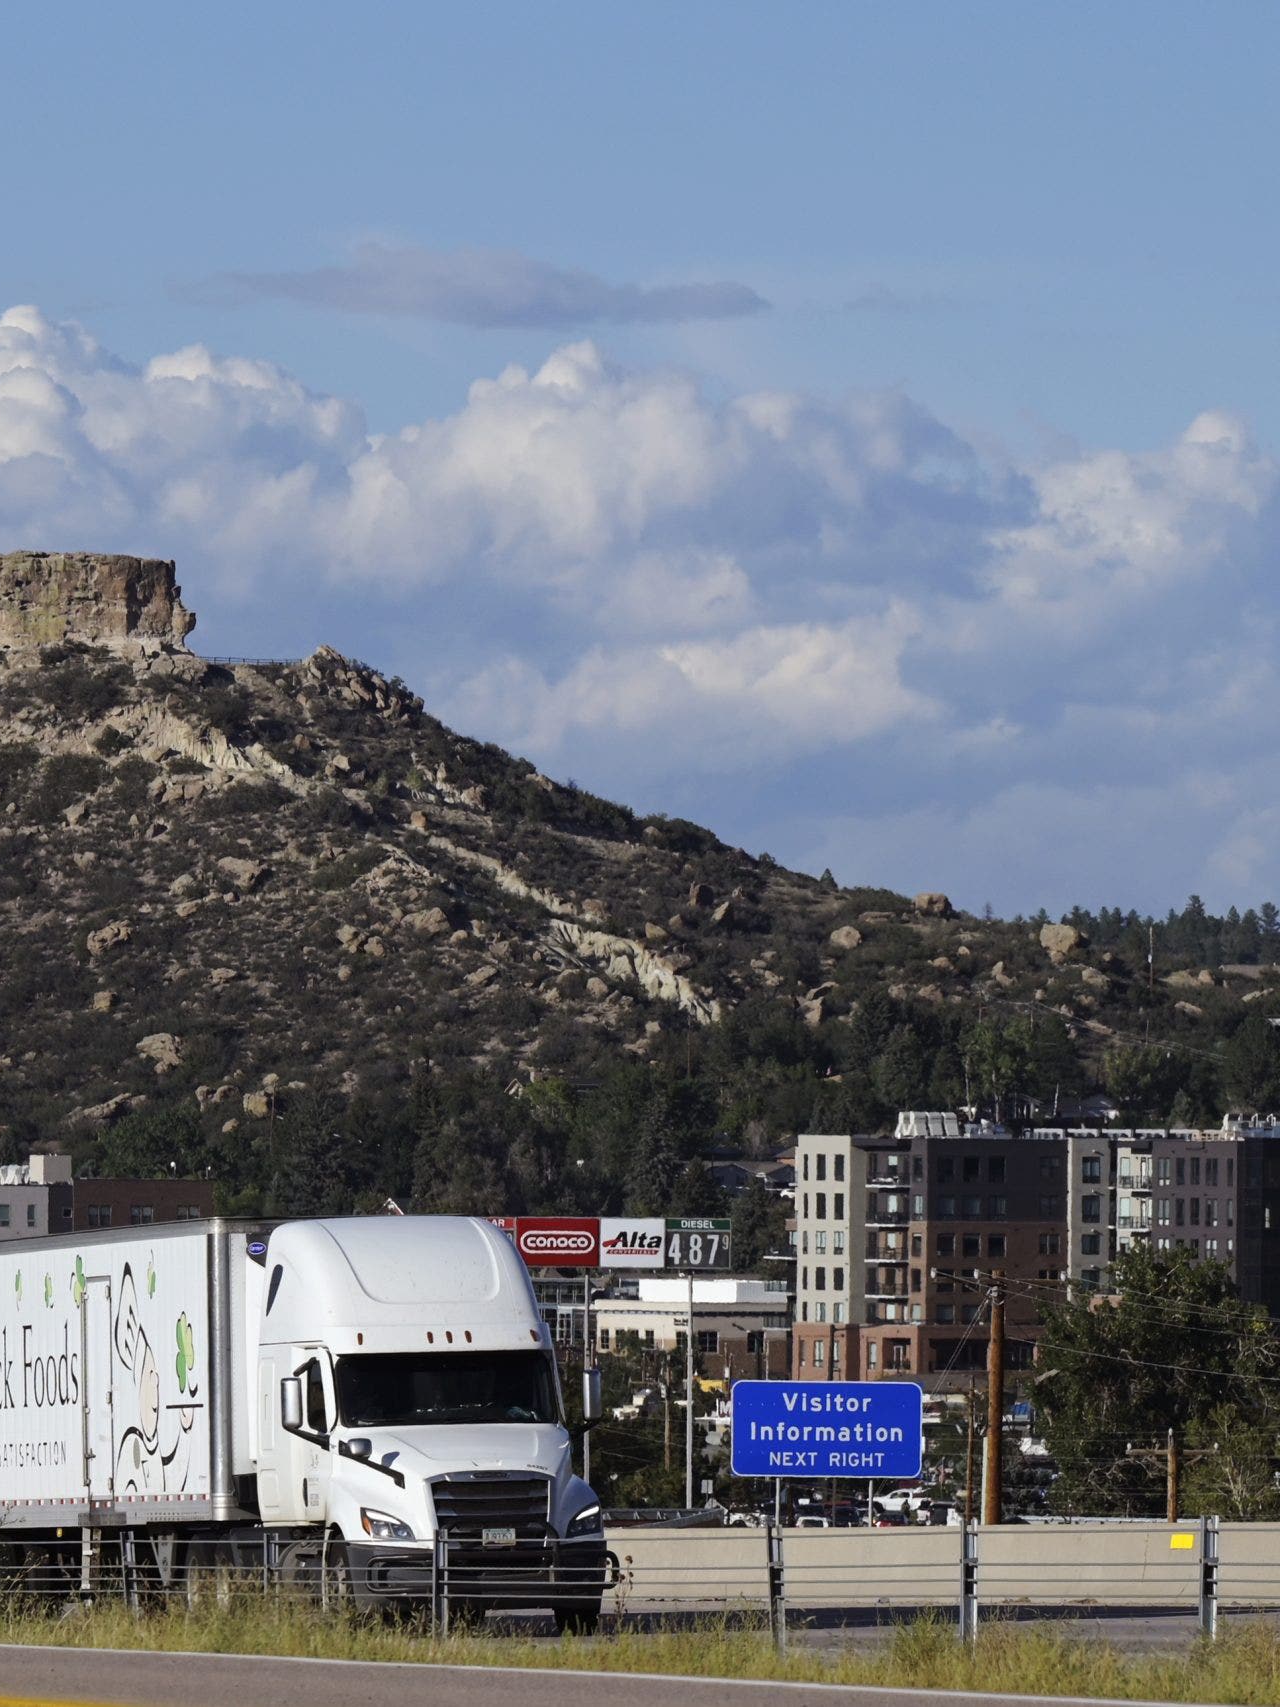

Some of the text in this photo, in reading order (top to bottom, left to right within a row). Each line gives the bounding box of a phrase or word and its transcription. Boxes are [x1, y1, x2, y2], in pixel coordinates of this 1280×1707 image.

[681, 1220, 715, 1229] DIESEL
[607, 1231, 662, 1248] Alta
[22, 1319, 80, 1409] Foods
[782, 1392, 872, 1412] Visitor
[750, 1421, 903, 1442] Information
[769, 1451, 885, 1467] NEXT RIGHT
